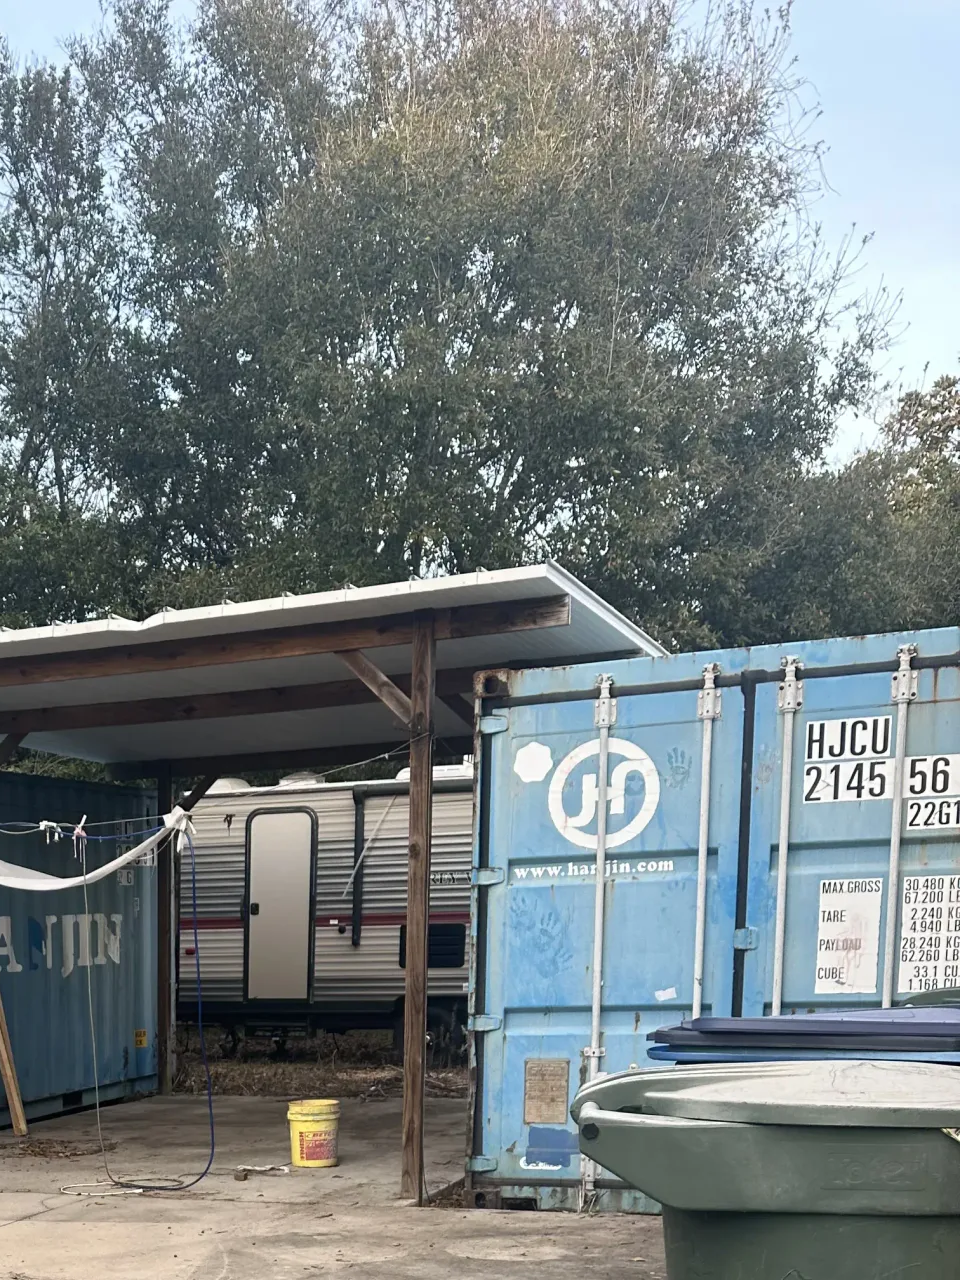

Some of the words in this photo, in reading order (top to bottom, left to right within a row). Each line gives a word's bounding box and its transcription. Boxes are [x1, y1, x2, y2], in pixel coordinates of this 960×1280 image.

[807, 718, 890, 759] HJCU
[805, 761, 886, 801] 2145
[910, 757, 950, 795] 56
[822, 881, 844, 894] MAX
[847, 880, 881, 893] GROSS
[821, 909, 847, 923] TARE
[819, 938, 862, 951] PAYLOAD
[946, 935, 960, 948] KG
[945, 949, 960, 961] LB
[817, 966, 845, 980] CUBE
